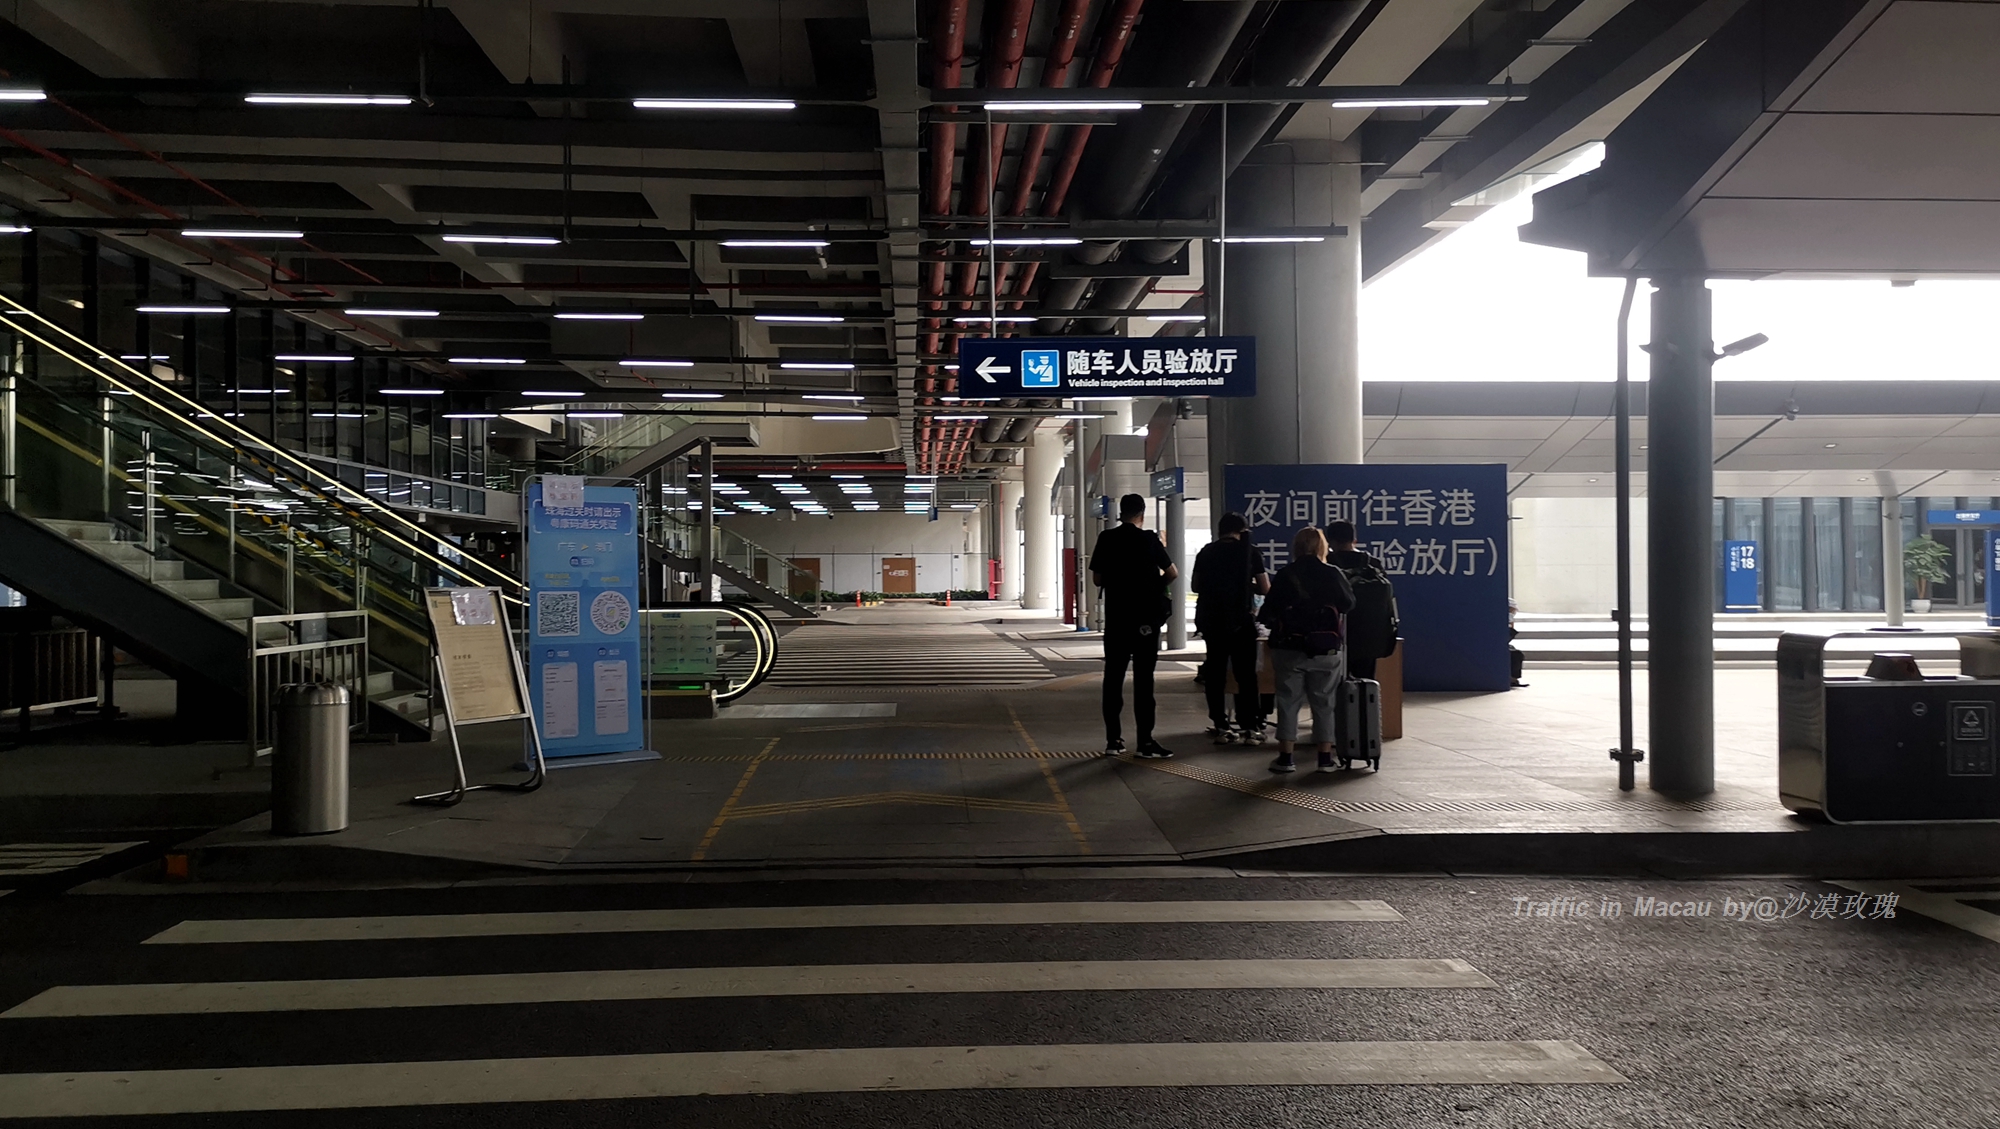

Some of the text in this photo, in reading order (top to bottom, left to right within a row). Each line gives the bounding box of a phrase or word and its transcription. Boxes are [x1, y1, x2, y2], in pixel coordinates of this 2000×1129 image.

[1067, 348, 1238, 376] 随车人员验放厅
[1068, 377, 1224, 388] Vehicle inspection and inspection hall
[1244, 489, 1476, 527] 夜间前往香港
[1740, 545, 1755, 557] 17
[1740, 557, 1755, 569] 18
